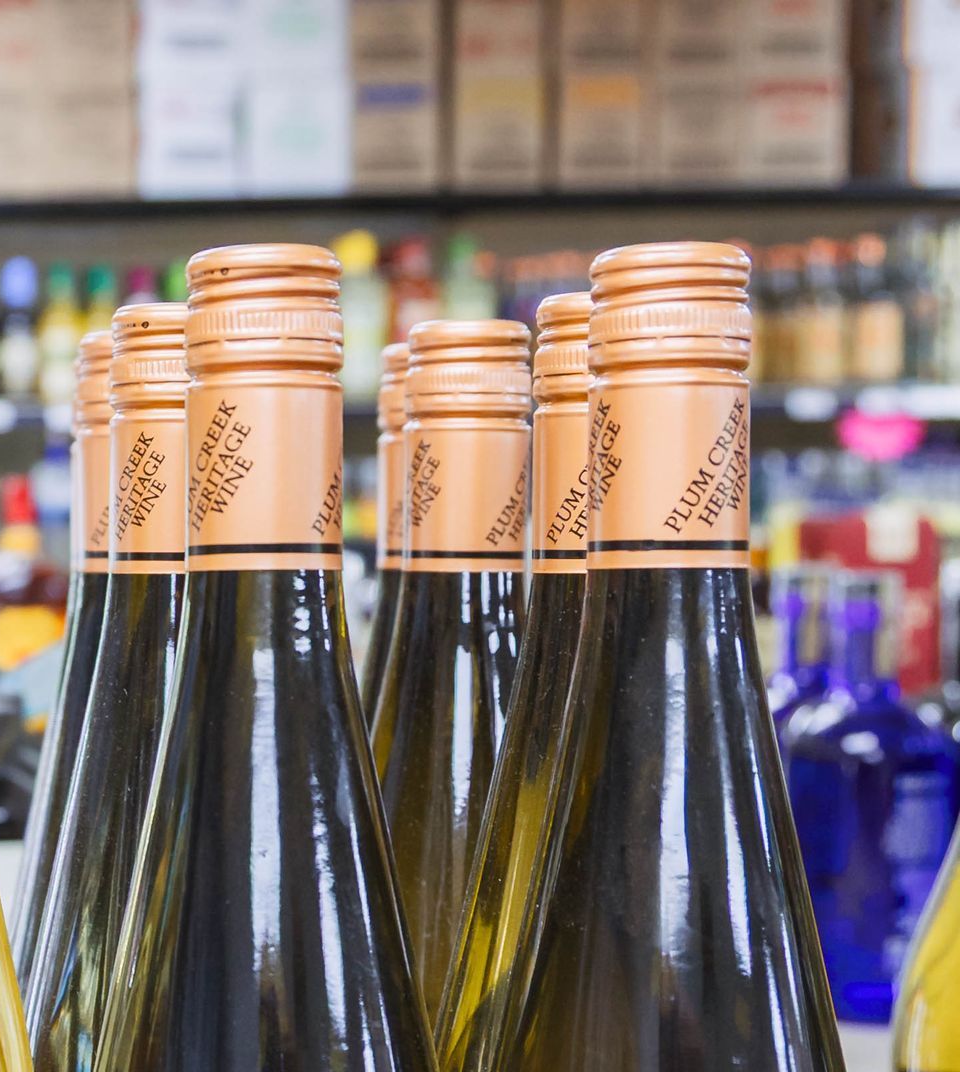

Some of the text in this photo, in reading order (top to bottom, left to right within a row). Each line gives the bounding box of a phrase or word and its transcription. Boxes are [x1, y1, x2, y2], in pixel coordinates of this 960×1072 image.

[119, 431, 154, 493] CREEK
[196, 400, 237, 472] CREEK
[664, 398, 745, 534] PLUM CREEK
[115, 450, 166, 541] HERITAGE
[131, 479, 168, 528] WINE
[192, 421, 252, 533] HERITAGE
[210, 456, 253, 514] WINE
[592, 454, 623, 512] WINE
[486, 496, 520, 546] PLUM
[546, 487, 585, 544] PLUM
